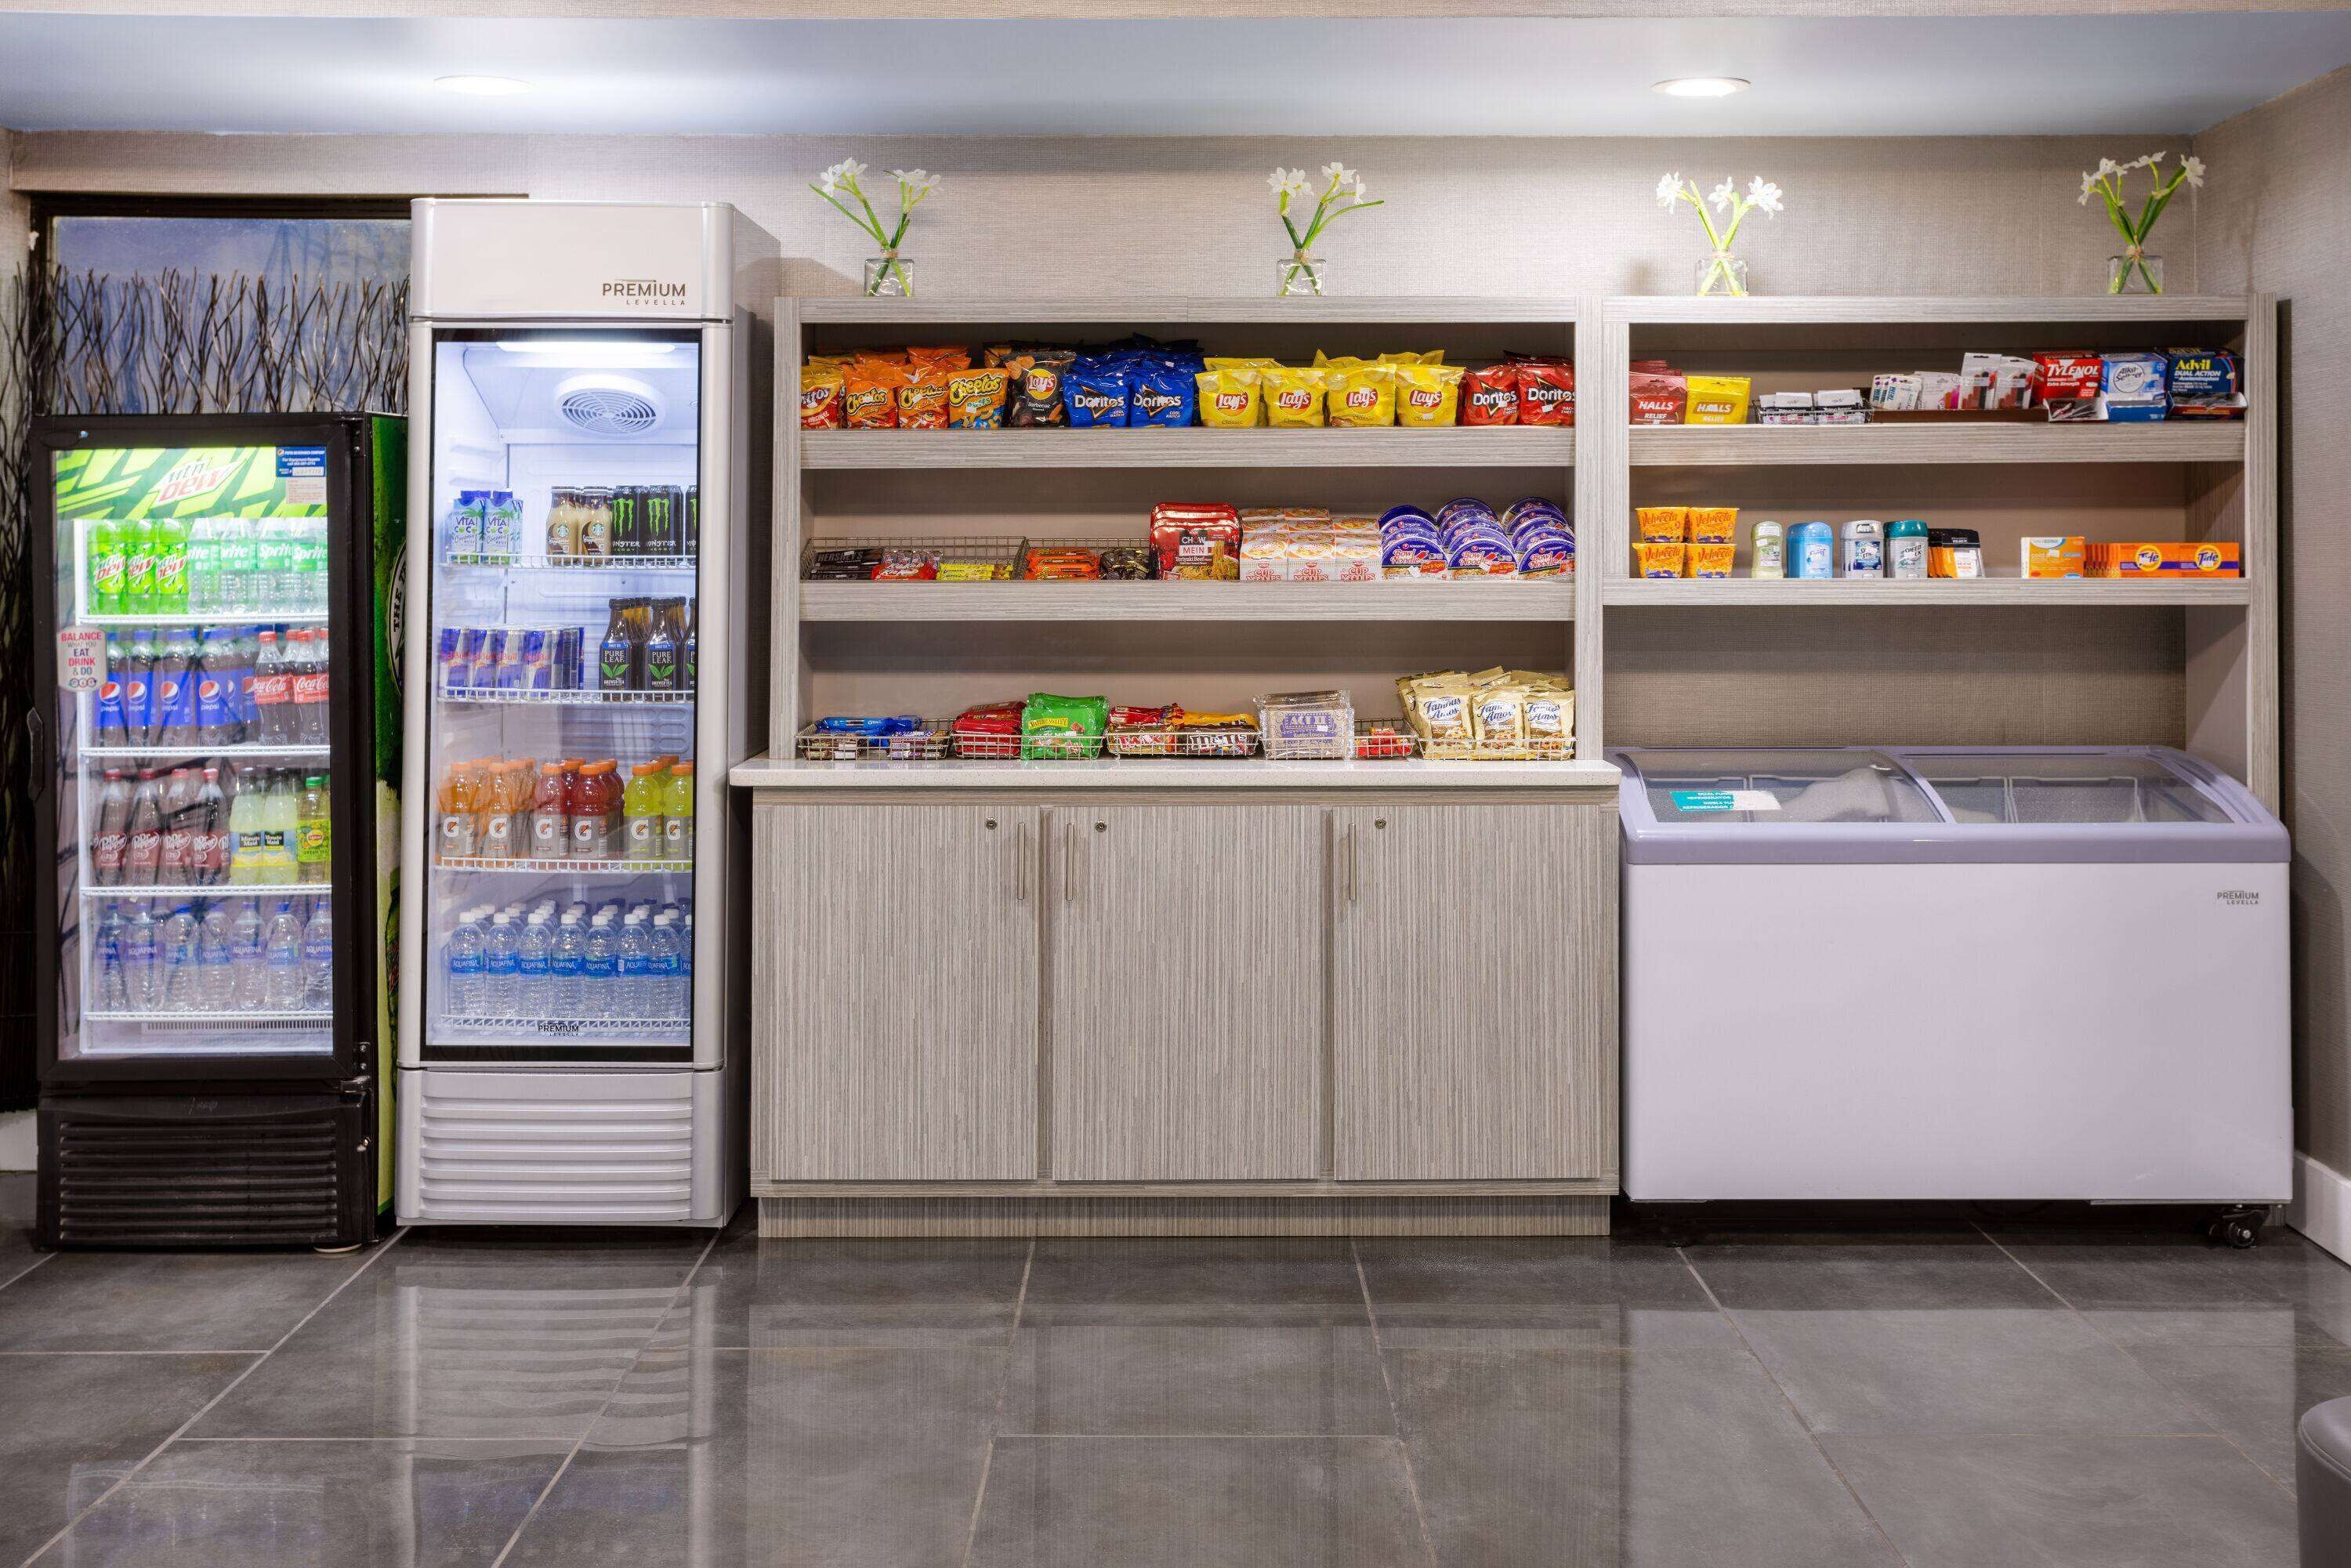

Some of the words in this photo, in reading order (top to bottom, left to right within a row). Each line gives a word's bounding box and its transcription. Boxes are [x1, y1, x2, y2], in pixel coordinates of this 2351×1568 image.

[602, 283, 686, 297] PREMIUM
[2175, 359, 2211, 370] Advil
[950, 374, 1002, 406] Cheetos
[1074, 394, 1125, 408] Doritos
[1473, 391, 1517, 405] Doritos
[1638, 401, 1675, 411] HALLS
[456, 516, 475, 526] VITA
[488, 517, 507, 527] VITA
[1393, 549, 1416, 557] Bowl
[1530, 551, 1554, 561] Bowl
[2139, 552, 2160, 566] Tde
[2197, 552, 2219, 566] Tide
[1459, 558, 1486, 567] Noodl
[393, 588, 402, 632] THE
[61, 632, 102, 642] BALANCE
[74, 648, 89, 657] EAT
[68, 657, 96, 667] DRINK
[81, 667, 92, 675] DO
[297, 674, 329, 692] Coca-Co
[1423, 697, 1462, 715] Famous
[1477, 704, 1516, 718] Fams
[1482, 711, 1513, 725] Amos
[444, 817, 460, 838] G
[488, 817, 507, 838] G
[535, 818, 552, 839] G
[574, 820, 592, 841] G
[631, 819, 650, 840] G
[666, 819, 681, 840] G
[233, 946, 263, 954] AQUAFINA
[453, 959, 479, 969] AQUAFINA
[522, 961, 547, 969] AQUAFINA
[552, 960, 576, 969] AQUAFINA
[586, 961, 610, 970] AQUAFINA
